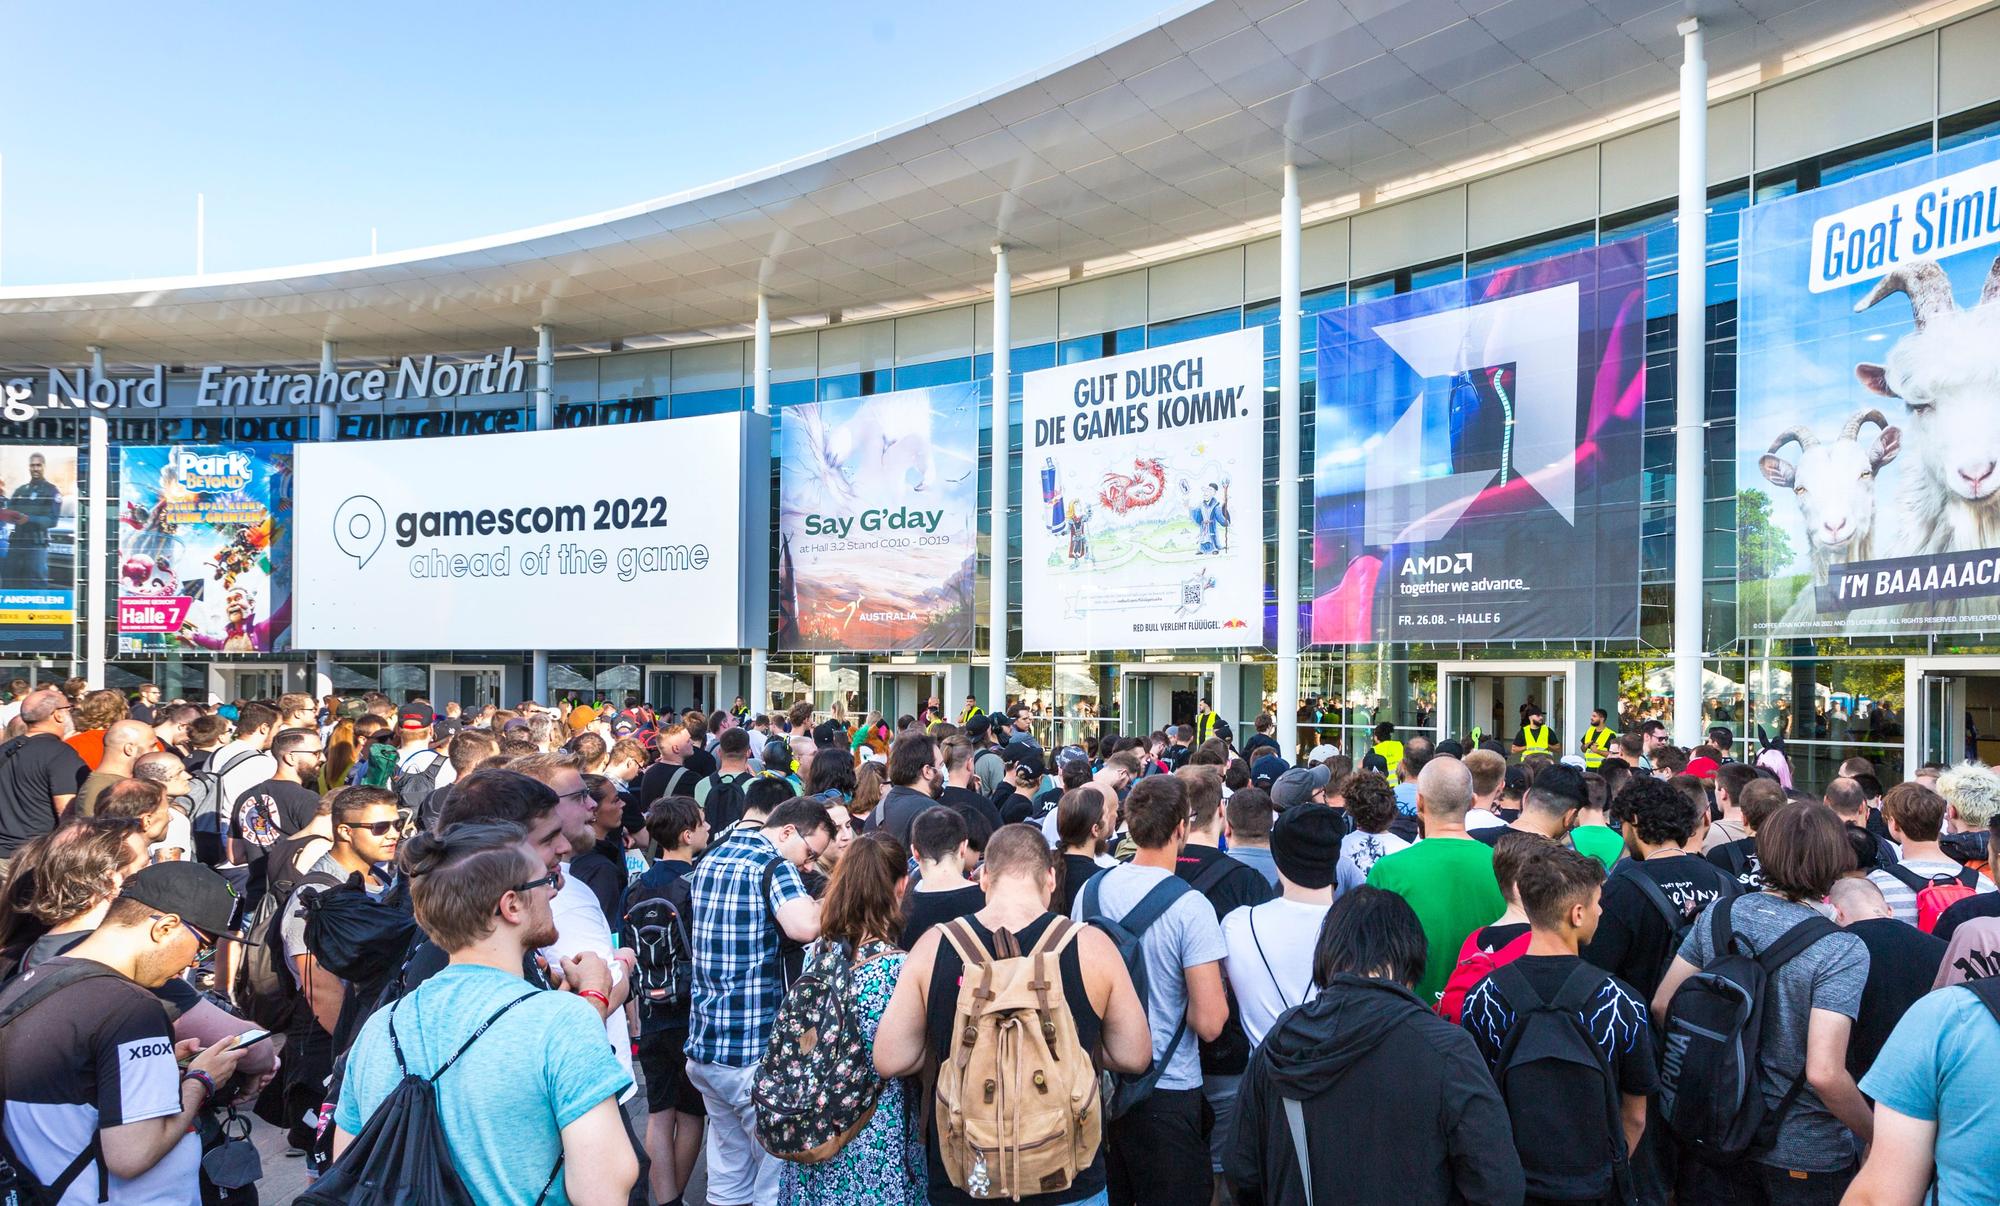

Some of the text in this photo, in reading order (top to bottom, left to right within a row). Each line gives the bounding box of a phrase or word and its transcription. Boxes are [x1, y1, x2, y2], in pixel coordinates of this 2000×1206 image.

[1823, 204, 1902, 281] Goat
[49, 364, 166, 408] Nord
[196, 366, 387, 407] Entrance
[395, 346, 527, 399] North
[1074, 357, 1203, 408] GUT DURCH
[1035, 415, 1066, 447] DIE
[1073, 402, 1149, 442] GAMES
[180, 453, 251, 480] Park
[187, 472, 245, 489] BEYOND
[396, 496, 668, 548] gamescom 2022
[805, 506, 945, 539] Say G'day
[799, 545, 810, 554] at
[811, 543, 829, 553] Hall
[830, 542, 846, 551] 3.2
[847, 540, 879, 551] Stand
[409, 543, 710, 582] ahead of the game
[1400, 556, 1453, 576] AMD
[1400, 580, 1450, 597] together
[1451, 582, 1469, 592] we
[1839, 572, 1870, 599] I'M
[122, 607, 180, 624] Halle 7
[859, 611, 918, 622] AUSTRALIA
[1133, 624, 1144, 632] RED
[1145, 623, 1159, 632] BULL
[1160, 622, 1187, 631] VERLEIHT
[1398, 615, 1415, 626] FR.
[1417, 615, 1447, 626] 26.08.
[1457, 613, 1492, 624] HALLE
[1493, 612, 1501, 623] 6
[1834, 619, 1846, 627] AND
[1959, 614, 1997, 622] DEVELOPED
[129, 1043, 172, 1061] XBOX
[1661, 1031, 1692, 1091] PUMA
